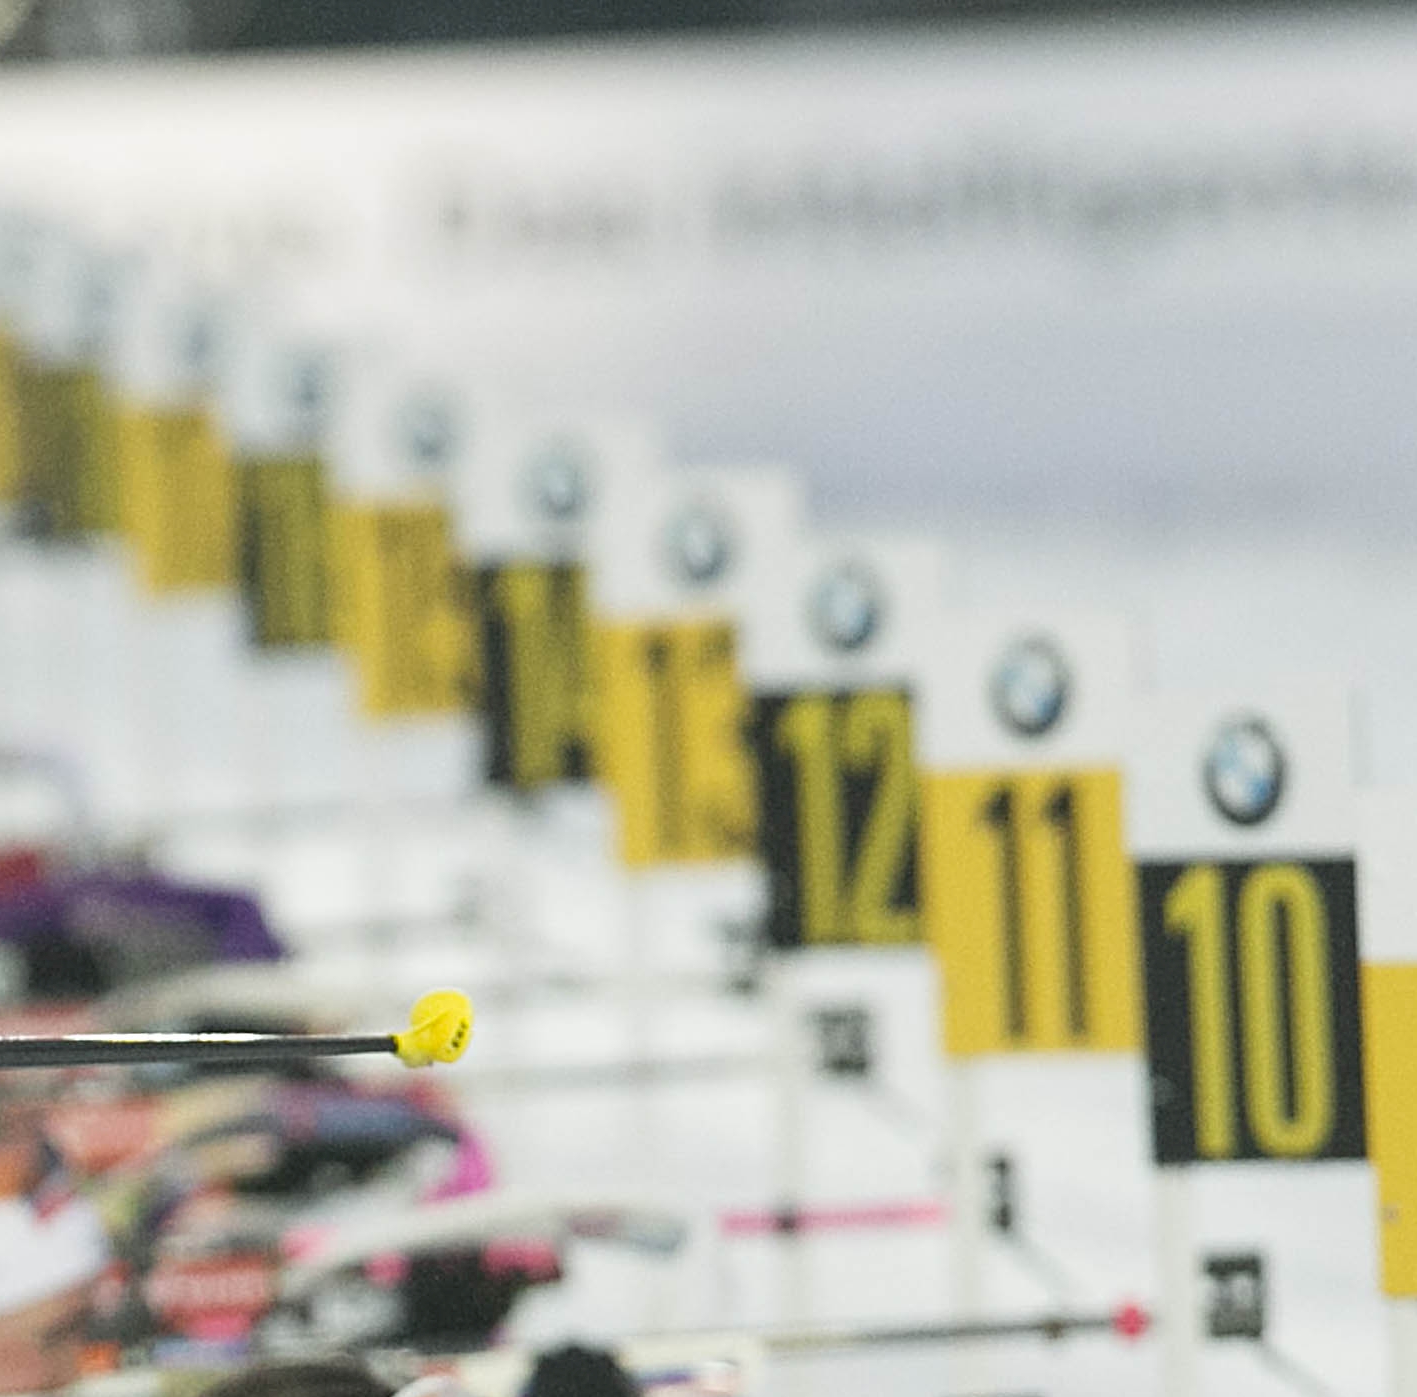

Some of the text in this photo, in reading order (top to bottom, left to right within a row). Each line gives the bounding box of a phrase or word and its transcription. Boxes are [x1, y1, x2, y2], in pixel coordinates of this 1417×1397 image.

[775, 689, 922, 944] 12
[983, 780, 1088, 1040] 11
[1166, 863, 1332, 1159] 10
